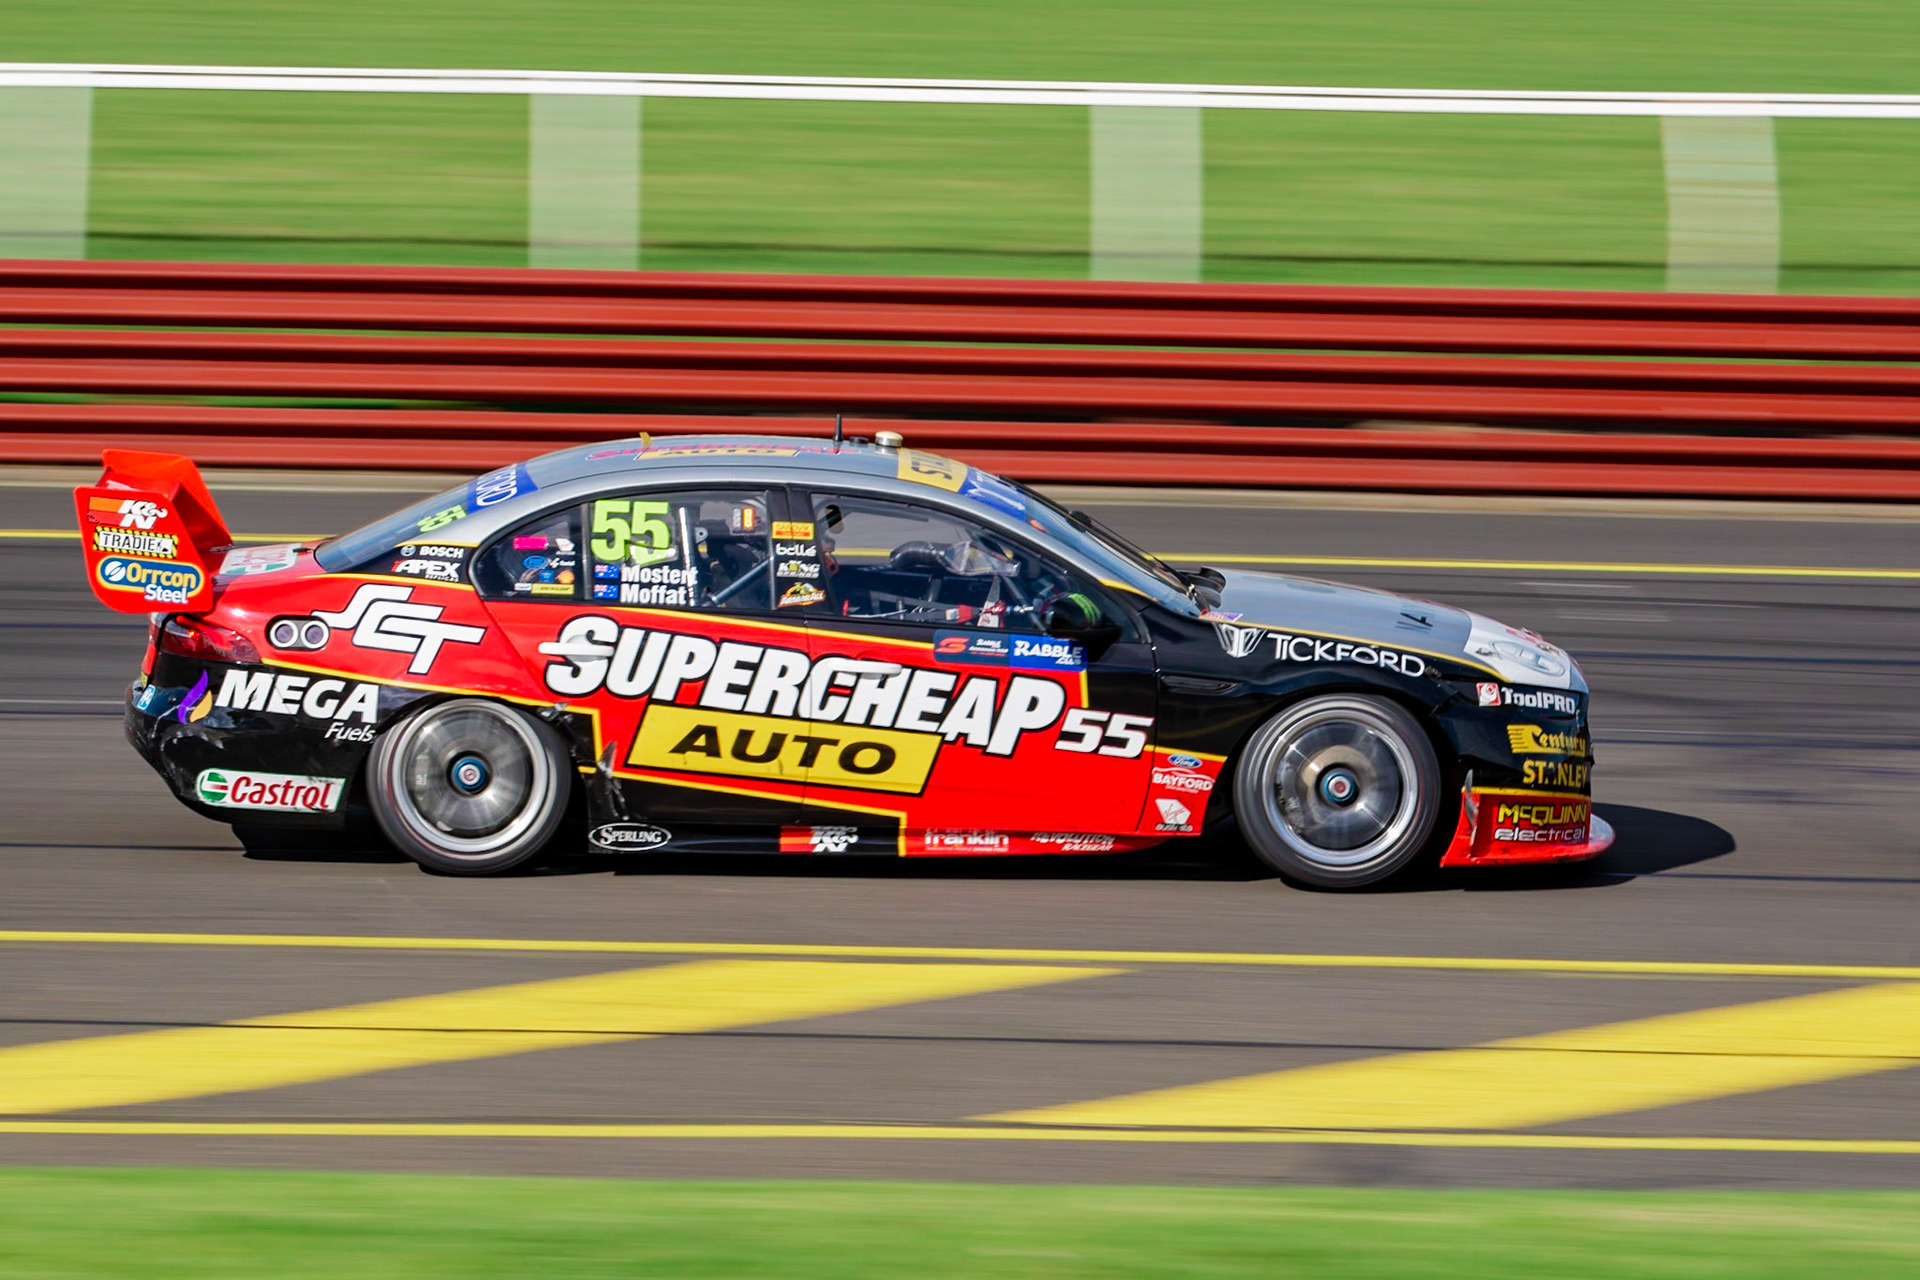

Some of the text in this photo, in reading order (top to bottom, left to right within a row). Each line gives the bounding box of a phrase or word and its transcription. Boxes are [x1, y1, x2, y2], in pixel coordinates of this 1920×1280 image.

[117, 499, 168, 529] K&N
[416, 505, 467, 532] 55
[103, 533, 156, 551] TRADIE
[591, 500, 670, 565] 55
[419, 545, 464, 559] BOSCH
[126, 562, 197, 589] Orrcon
[394, 559, 461, 578] APEX
[621, 564, 699, 585] Mostert
[144, 583, 188, 604] Steel
[620, 583, 687, 605] Moffat
[309, 583, 487, 675] SCT
[1267, 632, 1425, 677] TICKFORD
[215, 669, 379, 724] MEGA
[545, 614, 1066, 756] SUPERCHEAP
[1501, 687, 1576, 715] ToolPRO
[324, 722, 375, 743] Fuels
[1054, 707, 1154, 758] 55
[1507, 724, 1587, 757] Century
[669, 723, 897, 776] AUTO
[231, 776, 330, 809] Castrol
[1152, 773, 1213, 791] BAYFORD
[924, 828, 1009, 848] franklin
[1494, 826, 1586, 842] electrical
